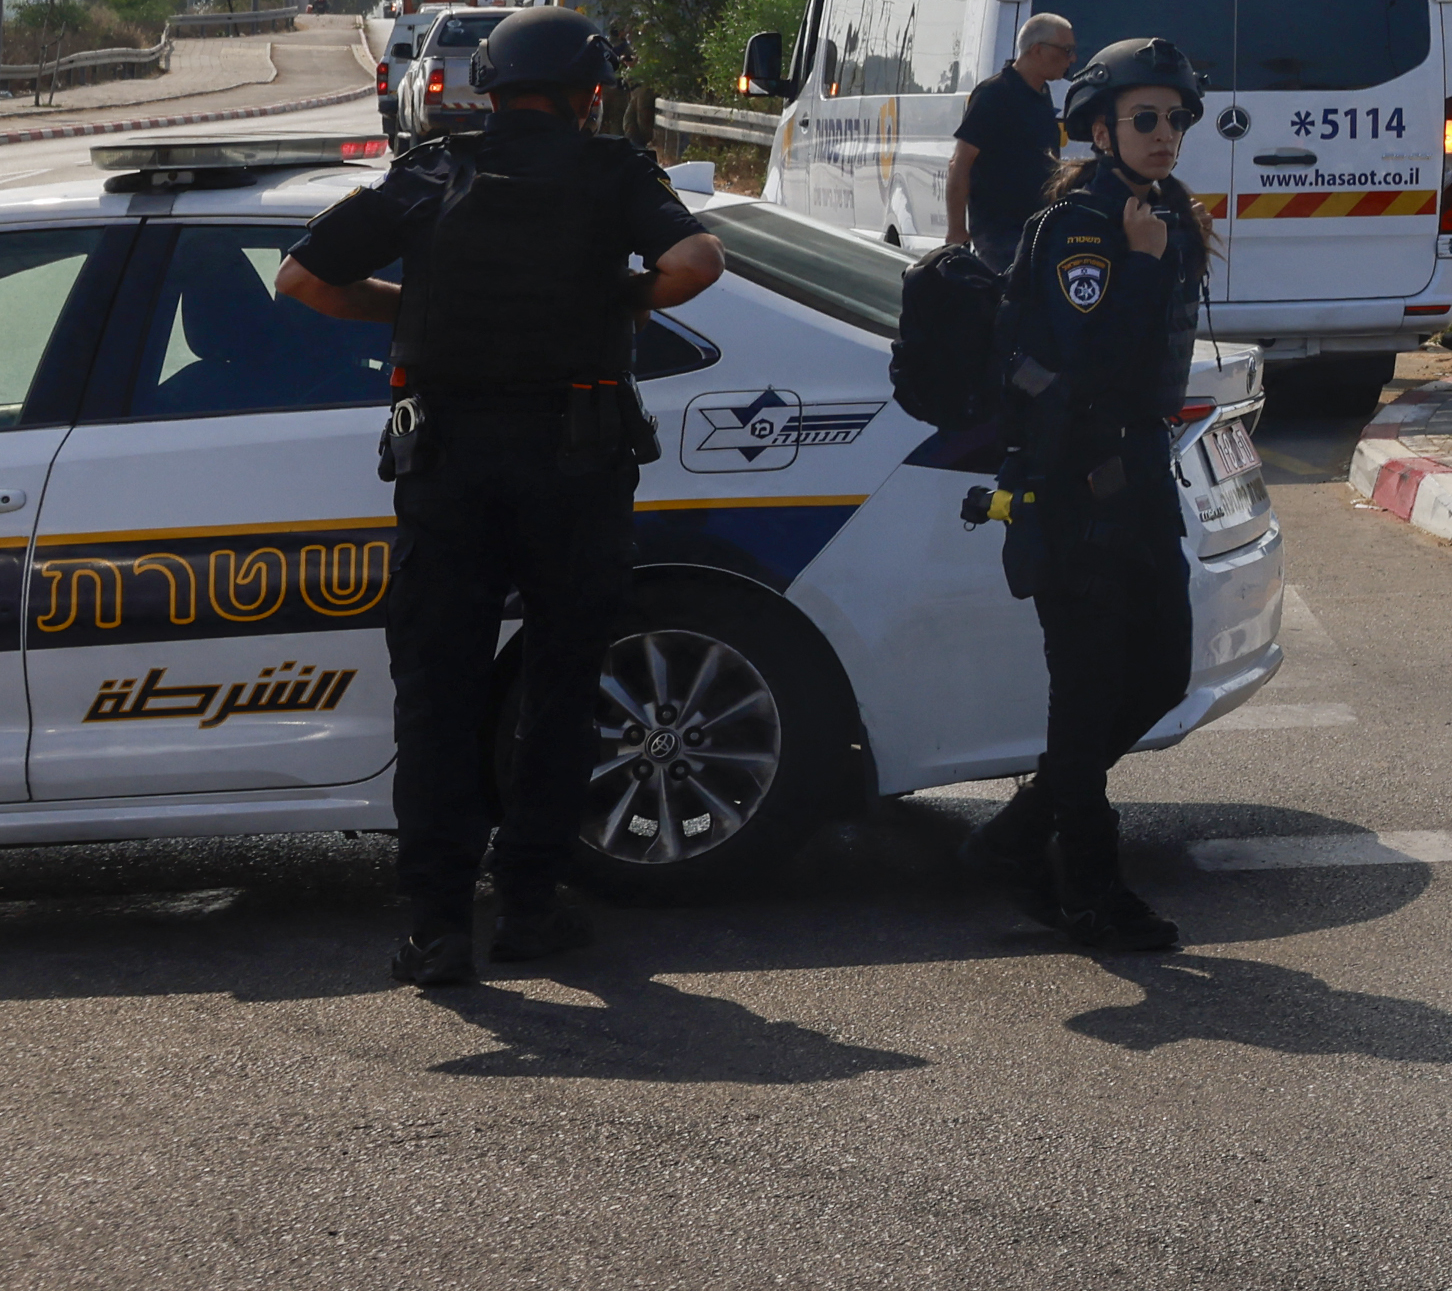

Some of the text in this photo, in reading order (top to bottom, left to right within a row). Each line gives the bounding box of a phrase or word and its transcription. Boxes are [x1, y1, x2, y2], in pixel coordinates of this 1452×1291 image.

[1259, 167, 1420, 187] www.hasaot.co.il
[772, 431, 852, 444] תנועה
[36, 540, 390, 633] שטרת
[81, 660, 359, 729] الشرطة
